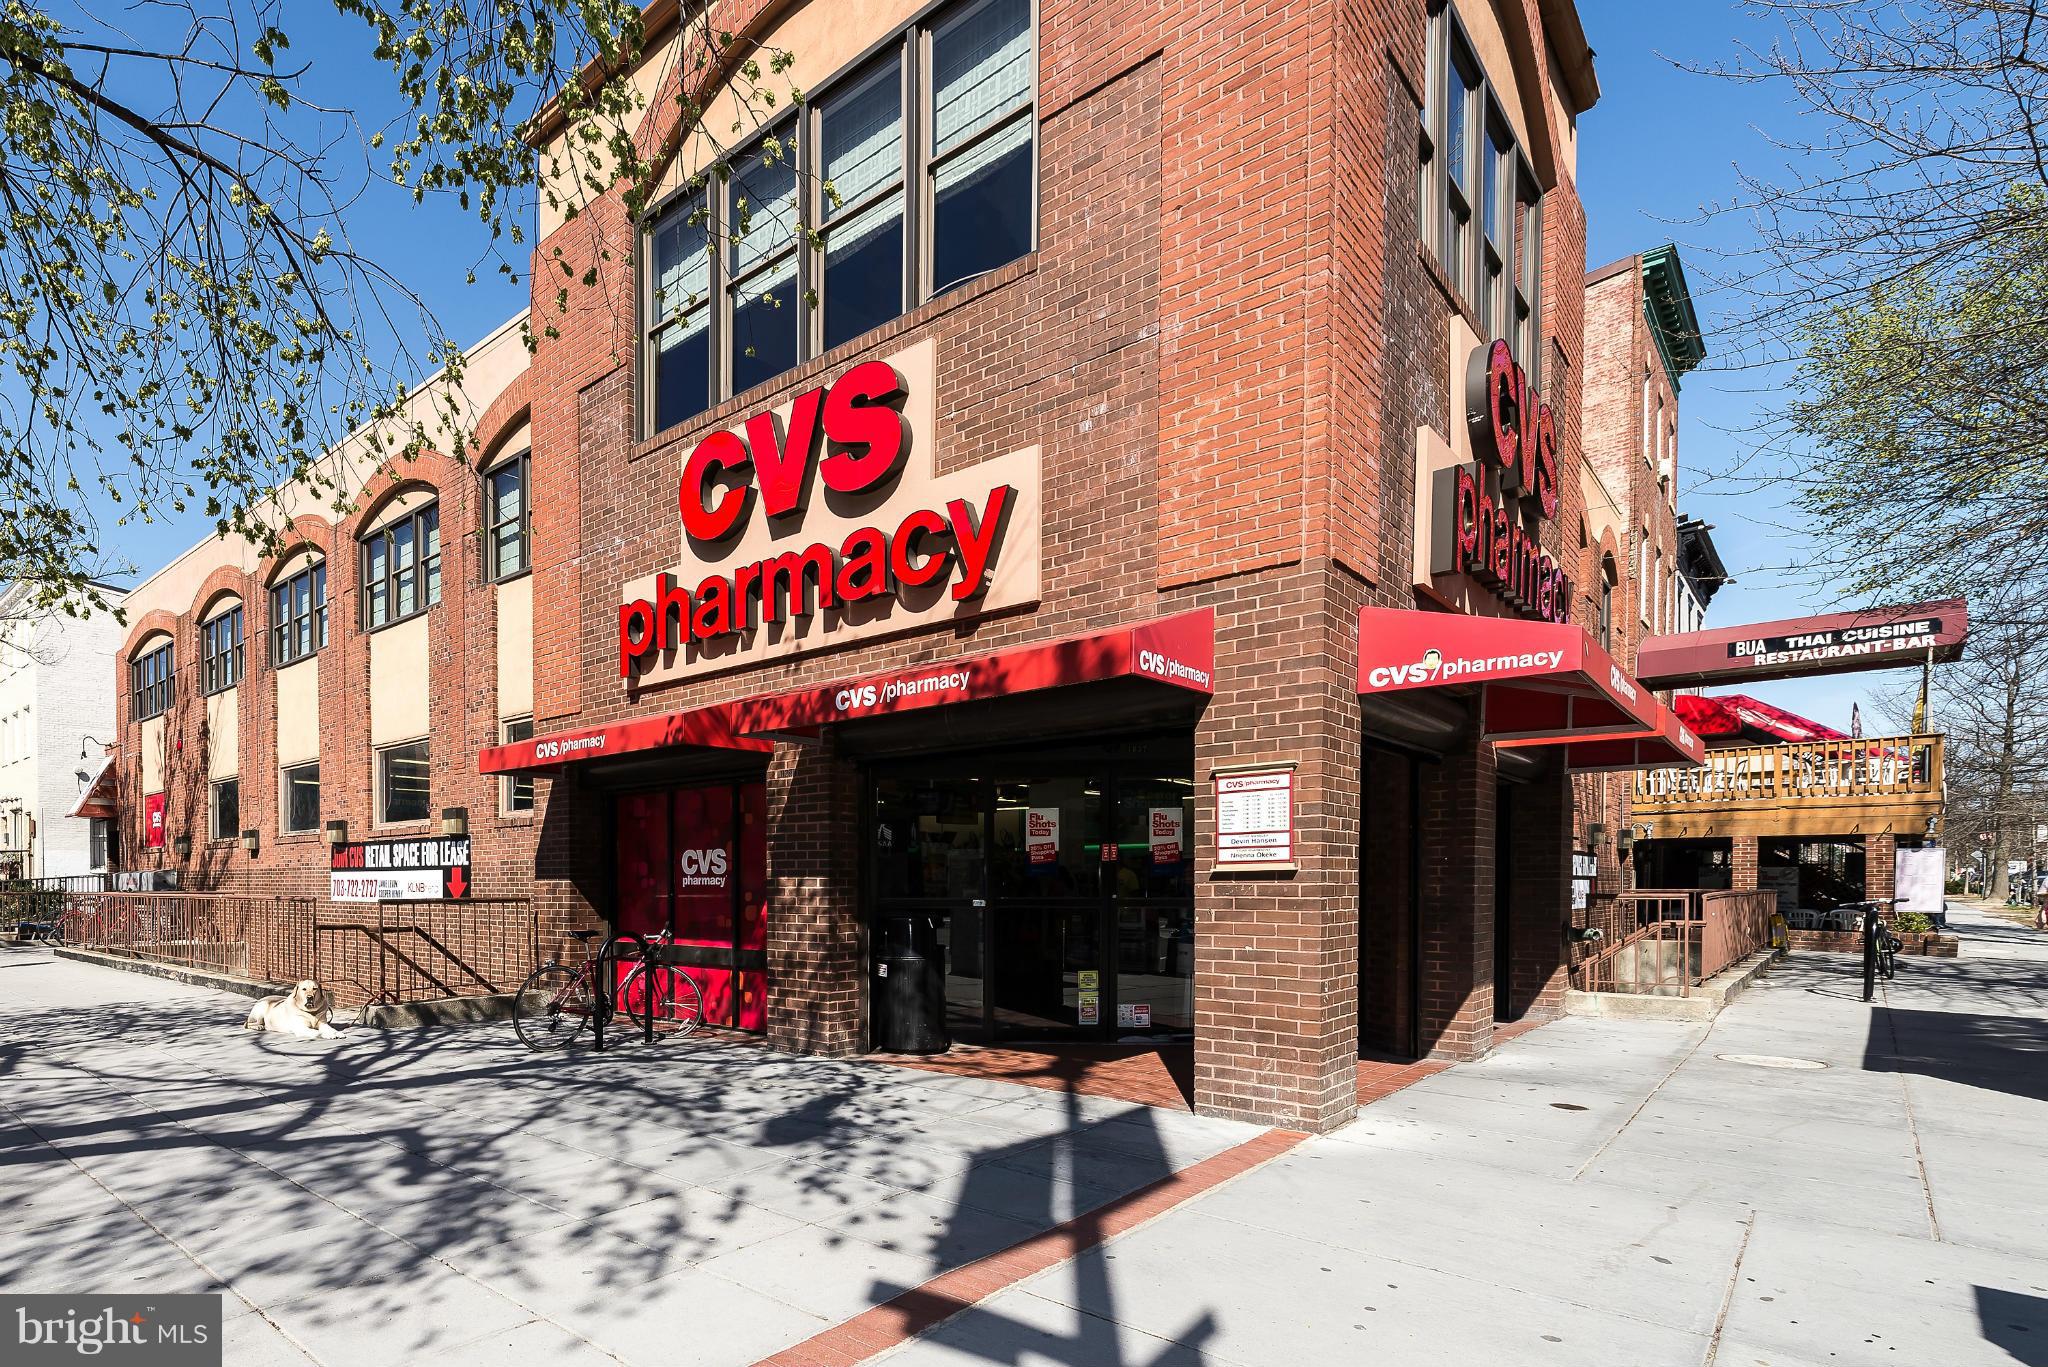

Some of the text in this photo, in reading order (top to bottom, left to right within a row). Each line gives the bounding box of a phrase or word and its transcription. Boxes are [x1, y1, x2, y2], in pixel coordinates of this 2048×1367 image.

[1478, 338, 1557, 520] CVS
[679, 360, 908, 541] CVS
[619, 485, 1016, 677] pharmacy
[1736, 621, 1930, 656] BUA THAI CUISINE
[1754, 635, 1936, 665] RESTAURANT-BAR
[1029, 820, 1056, 828] Shots
[1152, 820, 1180, 828] Shots
[349, 846, 364, 868] CVS
[365, 844, 392, 868] RETAIL
[392, 842, 420, 867] SPACE
[421, 841, 439, 866] FOR
[440, 839, 470, 866] LEASE
[682, 848, 727, 875] CVS
[332, 879, 378, 898] 703-722-2727
[682, 875, 725, 888] pharmacy
